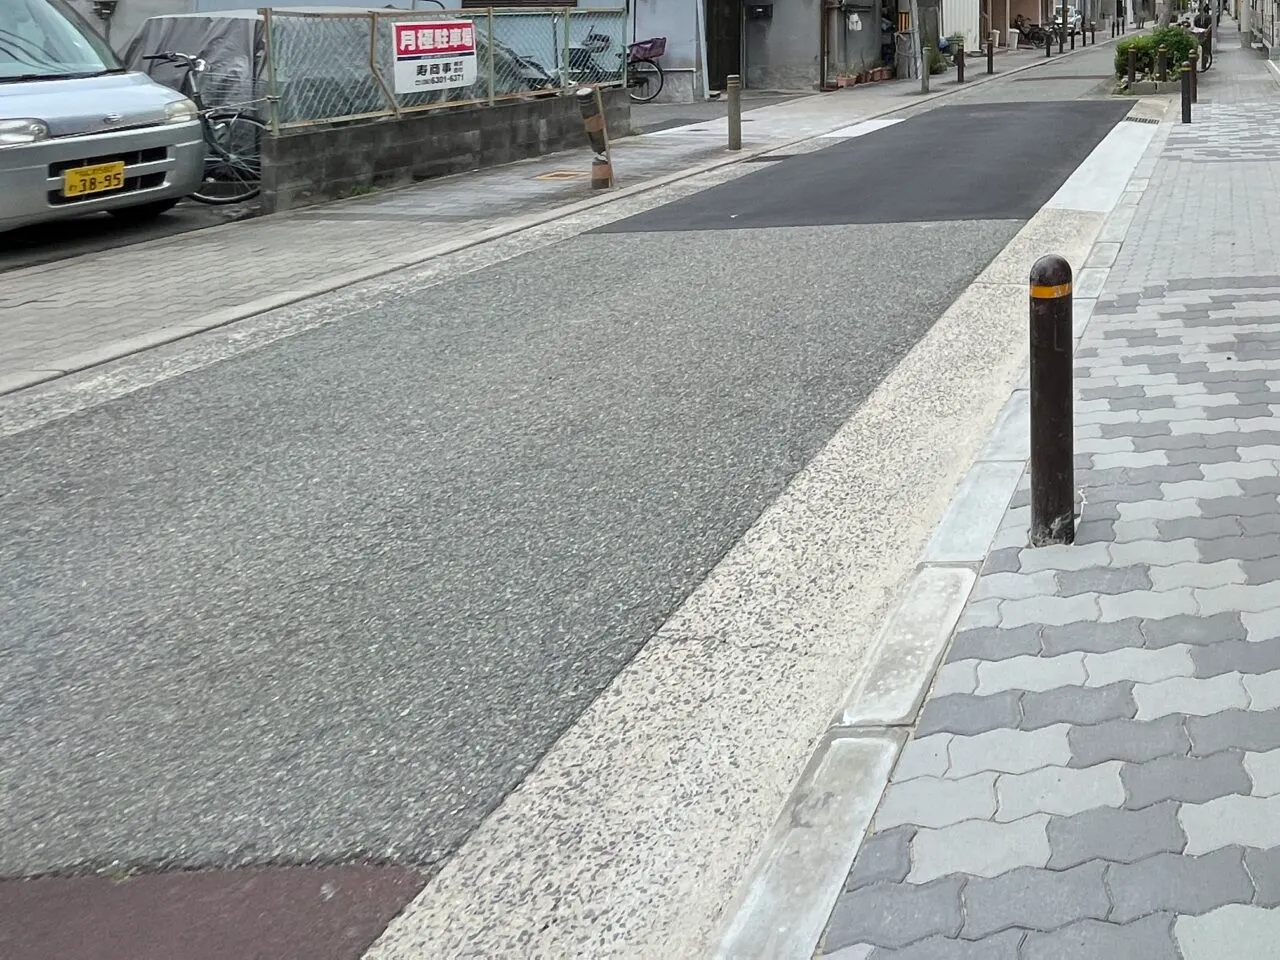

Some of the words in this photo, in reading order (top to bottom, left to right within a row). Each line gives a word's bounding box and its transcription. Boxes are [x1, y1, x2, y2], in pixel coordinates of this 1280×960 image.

[400, 27, 473, 51] 月極駐車場
